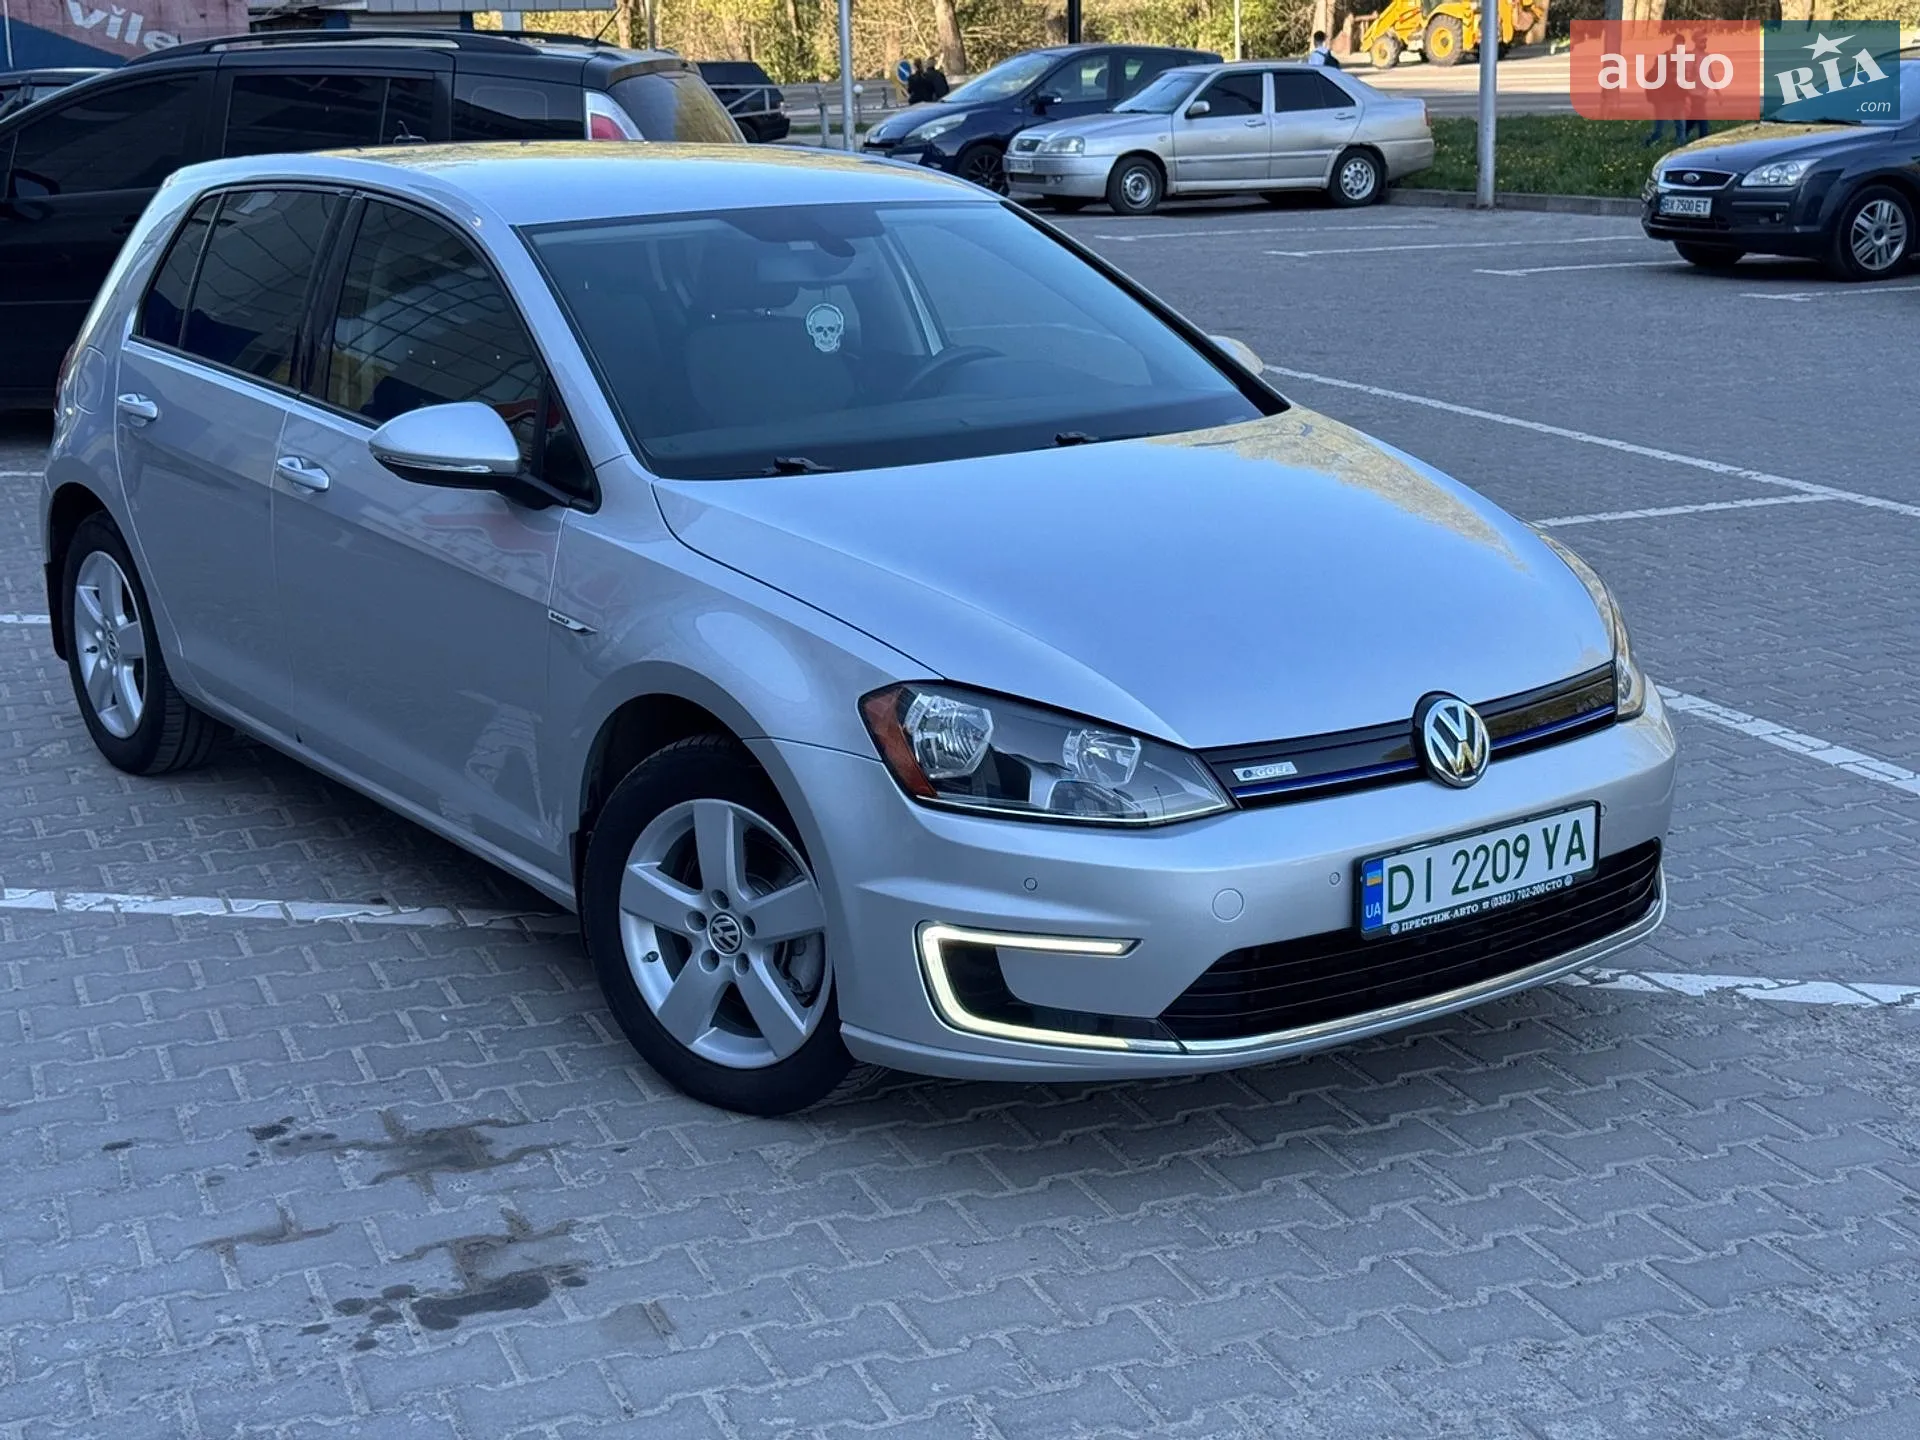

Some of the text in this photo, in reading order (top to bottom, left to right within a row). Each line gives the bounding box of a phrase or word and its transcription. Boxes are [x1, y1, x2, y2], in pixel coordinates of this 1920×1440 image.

[1387, 819, 1587, 913] DI 2209 YA
[1366, 901, 1381, 918] UA
